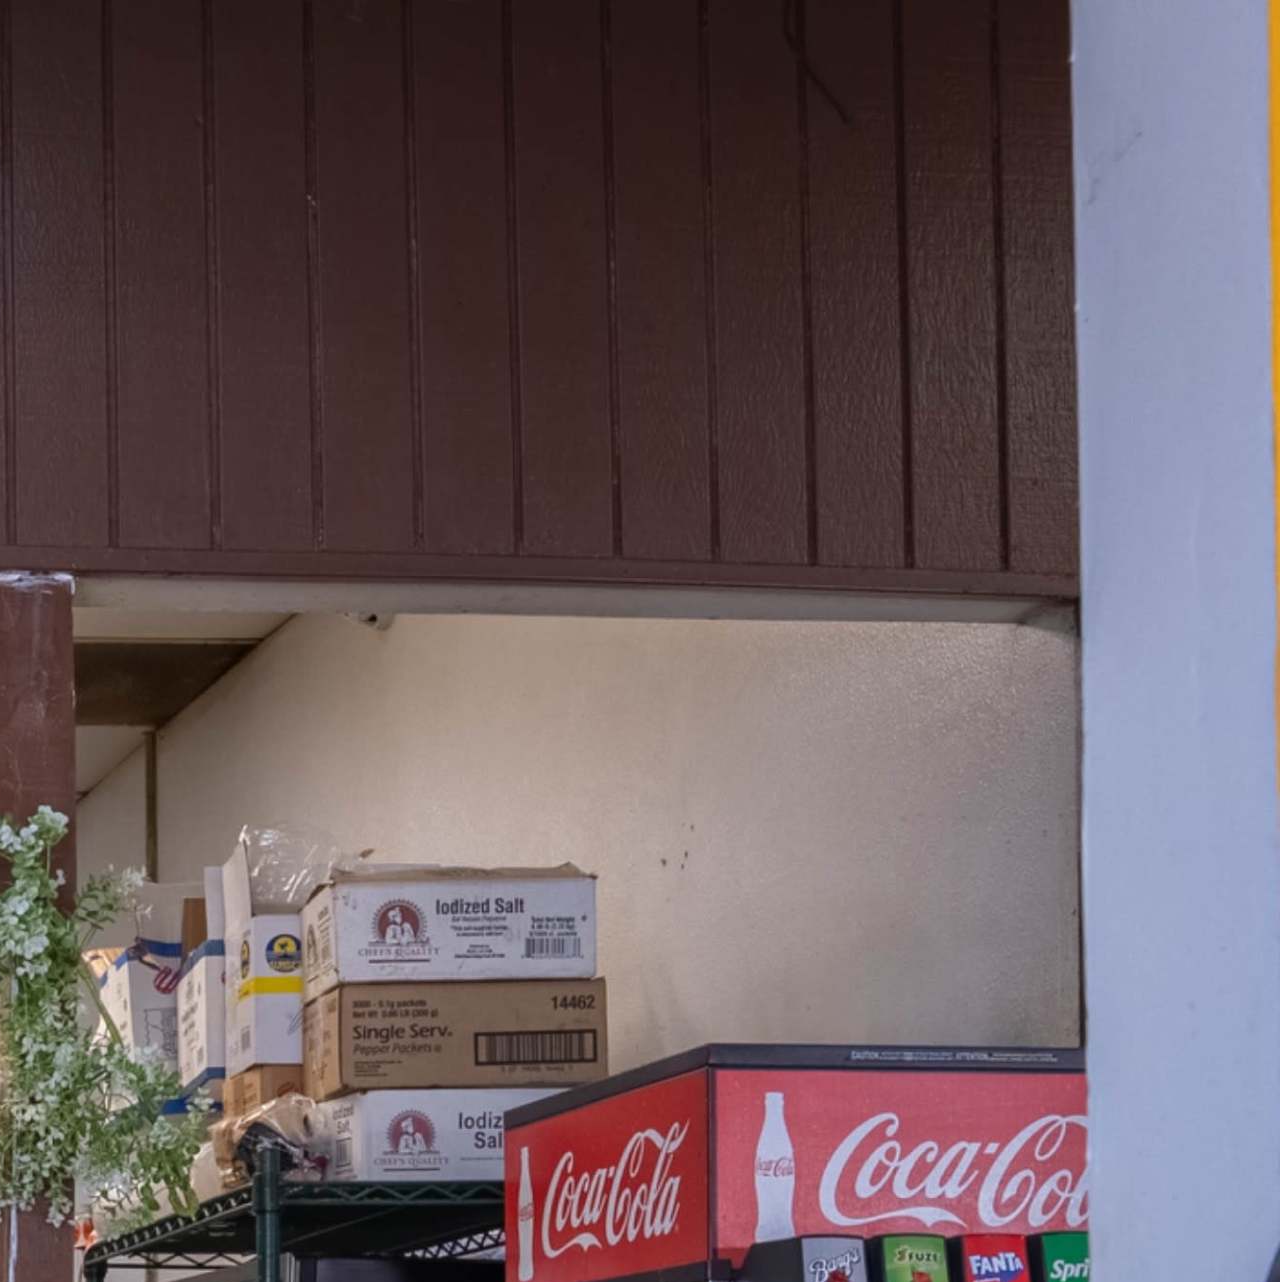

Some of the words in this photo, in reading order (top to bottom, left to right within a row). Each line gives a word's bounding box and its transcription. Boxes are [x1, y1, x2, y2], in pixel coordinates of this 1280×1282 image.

[435, 898, 491, 916] Iodized
[494, 897, 525, 915] Salt
[394, 947, 440, 958] QUALITY
[551, 994, 596, 1010] 14462
[352, 1025, 406, 1044] Single
[353, 1044, 391, 1056] Pepper
[392, 1043, 432, 1054] Packets
[457, 1111, 504, 1130] Iodiz
[474, 1131, 504, 1149] Sal
[408, 1156, 449, 1168] QUALITY
[542, 1118, 690, 1258] Coca-Cola
[968, 1251, 1025, 1275] FANTA
[1049, 1257, 1090, 1282] Spri
